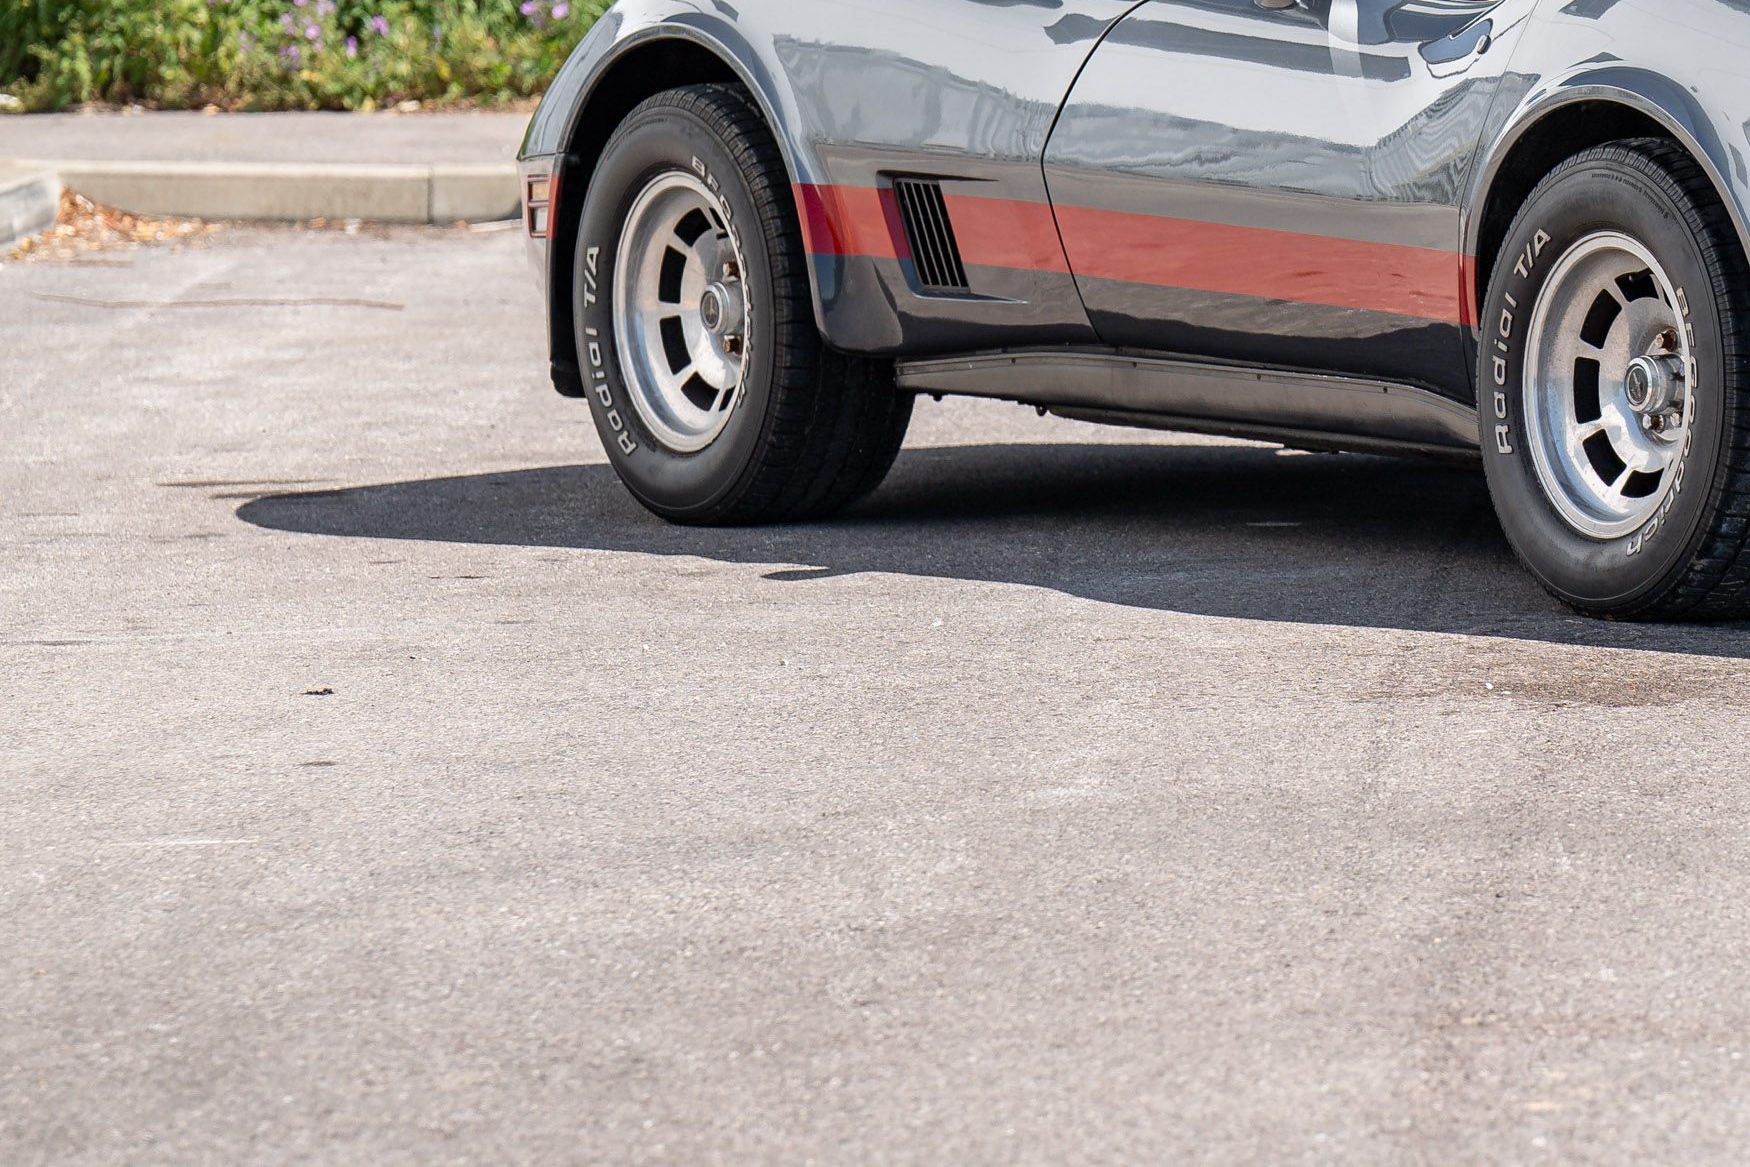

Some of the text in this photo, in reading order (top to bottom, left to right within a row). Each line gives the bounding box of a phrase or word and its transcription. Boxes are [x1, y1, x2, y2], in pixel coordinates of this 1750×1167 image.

[584, 245, 637, 456] Radial T/A
[1492, 228, 1552, 454] Radial T/A
